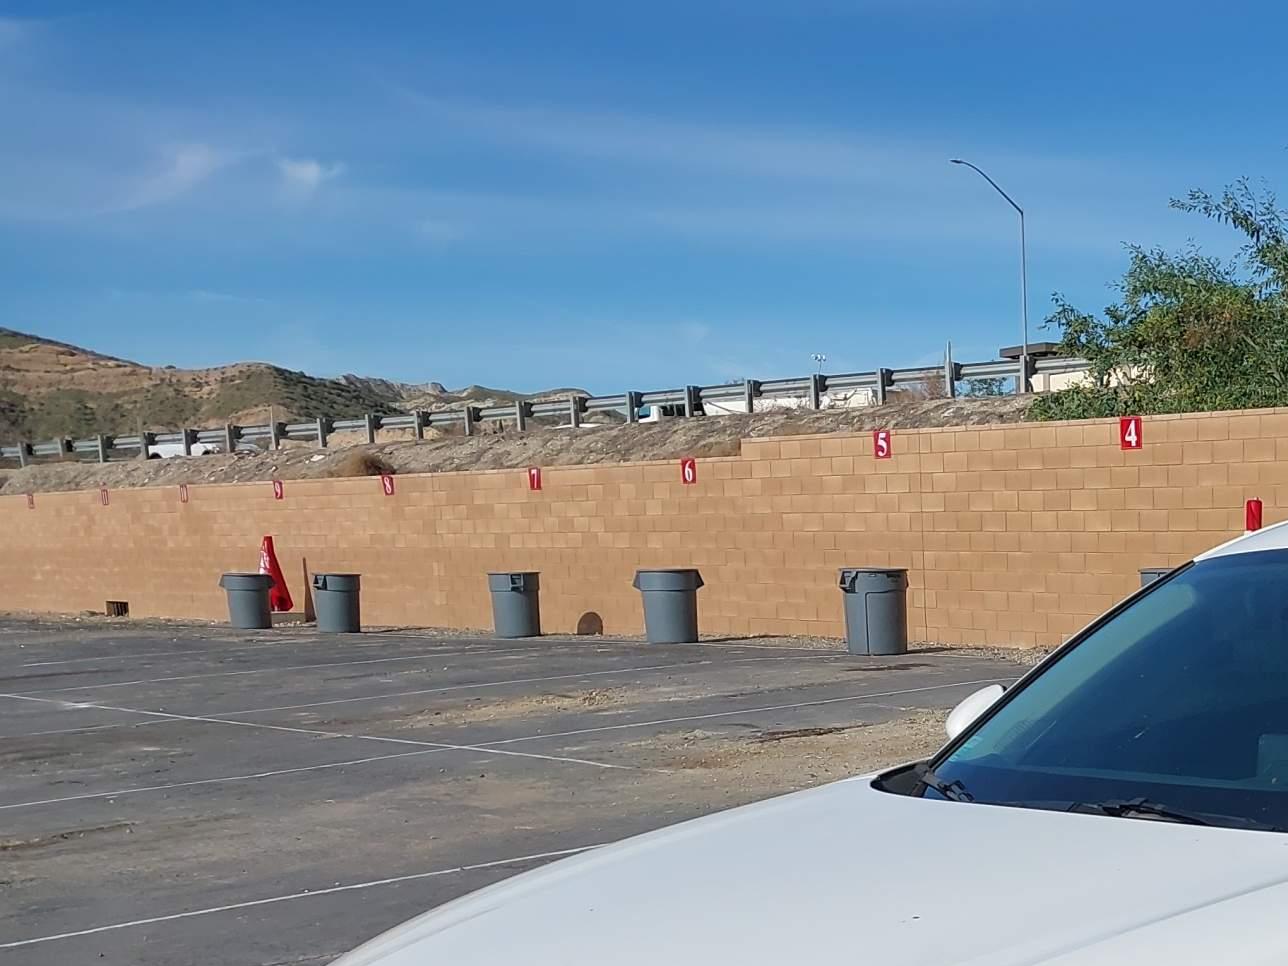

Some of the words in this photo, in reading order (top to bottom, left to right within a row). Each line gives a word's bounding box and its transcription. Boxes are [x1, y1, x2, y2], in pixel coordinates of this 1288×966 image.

[1124, 419, 1138, 446] 4
[877, 432, 887, 457] 5
[531, 468, 538, 488] 7
[684, 460, 693, 481] 6
[274, 482, 281, 498] 9
[383, 476, 392, 494] 8
